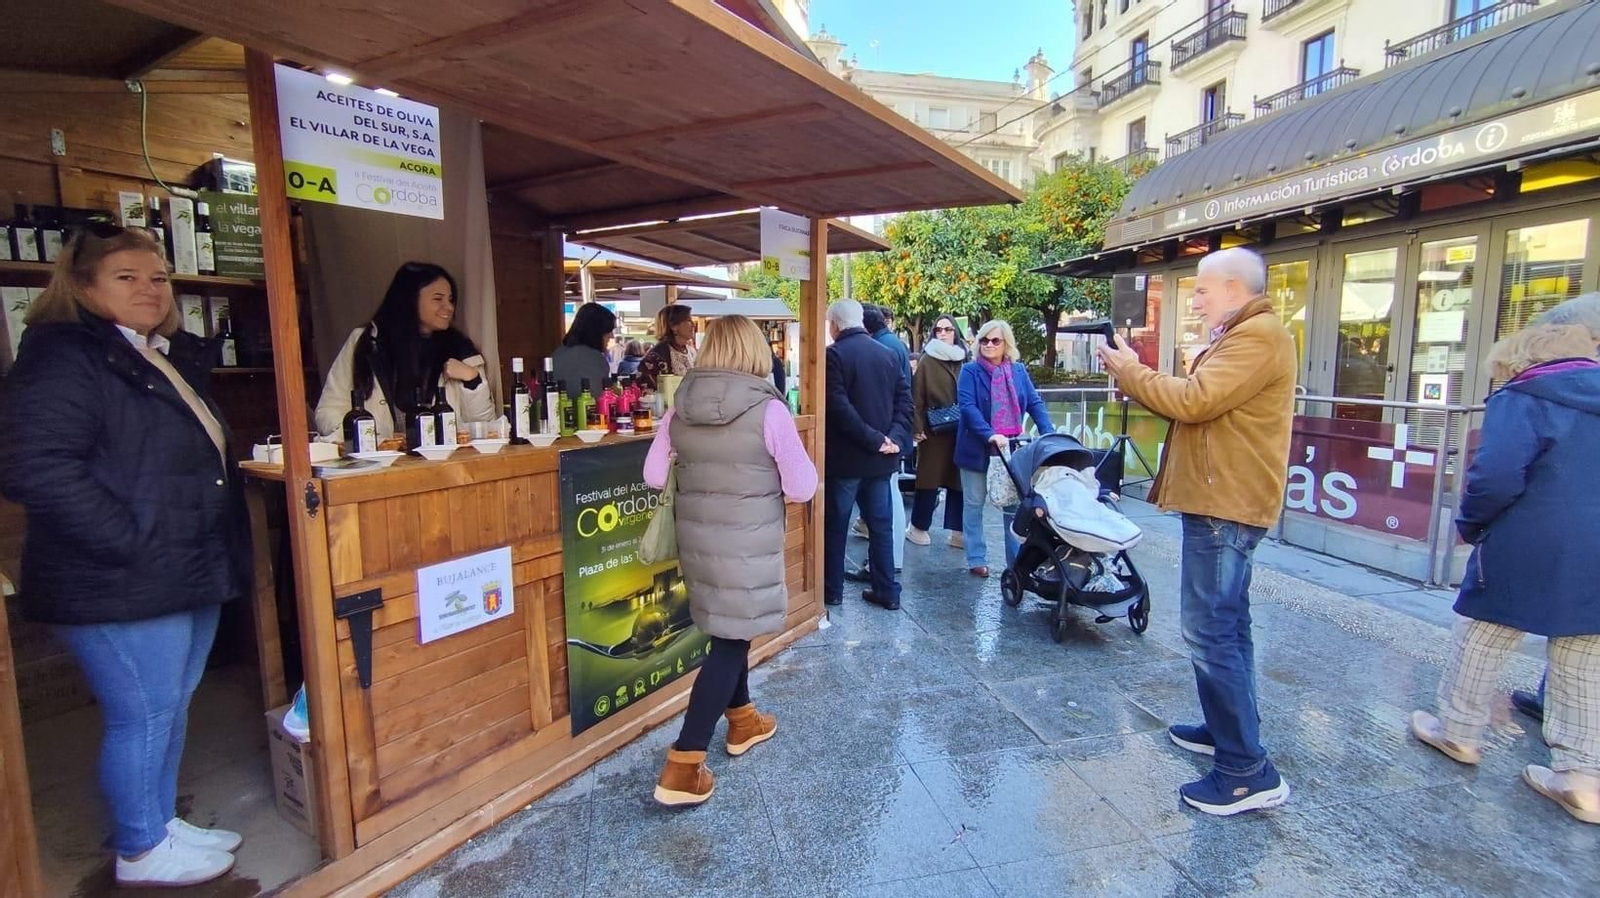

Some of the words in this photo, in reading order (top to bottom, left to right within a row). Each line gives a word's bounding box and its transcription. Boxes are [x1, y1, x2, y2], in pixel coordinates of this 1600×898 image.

[316, 90, 373, 112] ACEITES
[376, 105, 394, 118] DE
[396, 110, 434, 128] OLIVA
[290, 116, 307, 129] EL
[309, 120, 360, 142] VILLAR
[362, 133, 381, 146] DE
[383, 138, 400, 151] LA
[401, 141, 436, 158] VEGA
[353, 115, 379, 130] DEL
[381, 122, 410, 138] SUR,
[412, 129, 434, 142] S.A.
[399, 161, 437, 176] ACORA
[1303, 166, 1369, 193] Turística
[217, 203, 228, 213] el
[229, 202, 260, 216] villar
[232, 224, 262, 237] vega
[763, 260, 780, 272] 10-B
[575, 487, 612, 505] Festival
[613, 483, 629, 497] del
[630, 482, 651, 493] Acei
[1286, 445, 1358, 519] ás
[618, 510, 654, 527] virgene
[437, 562, 497, 587] BUJALANCE
[578, 562, 604, 578] Plaza
[605, 557, 619, 569] de
[620, 552, 633, 564] las
